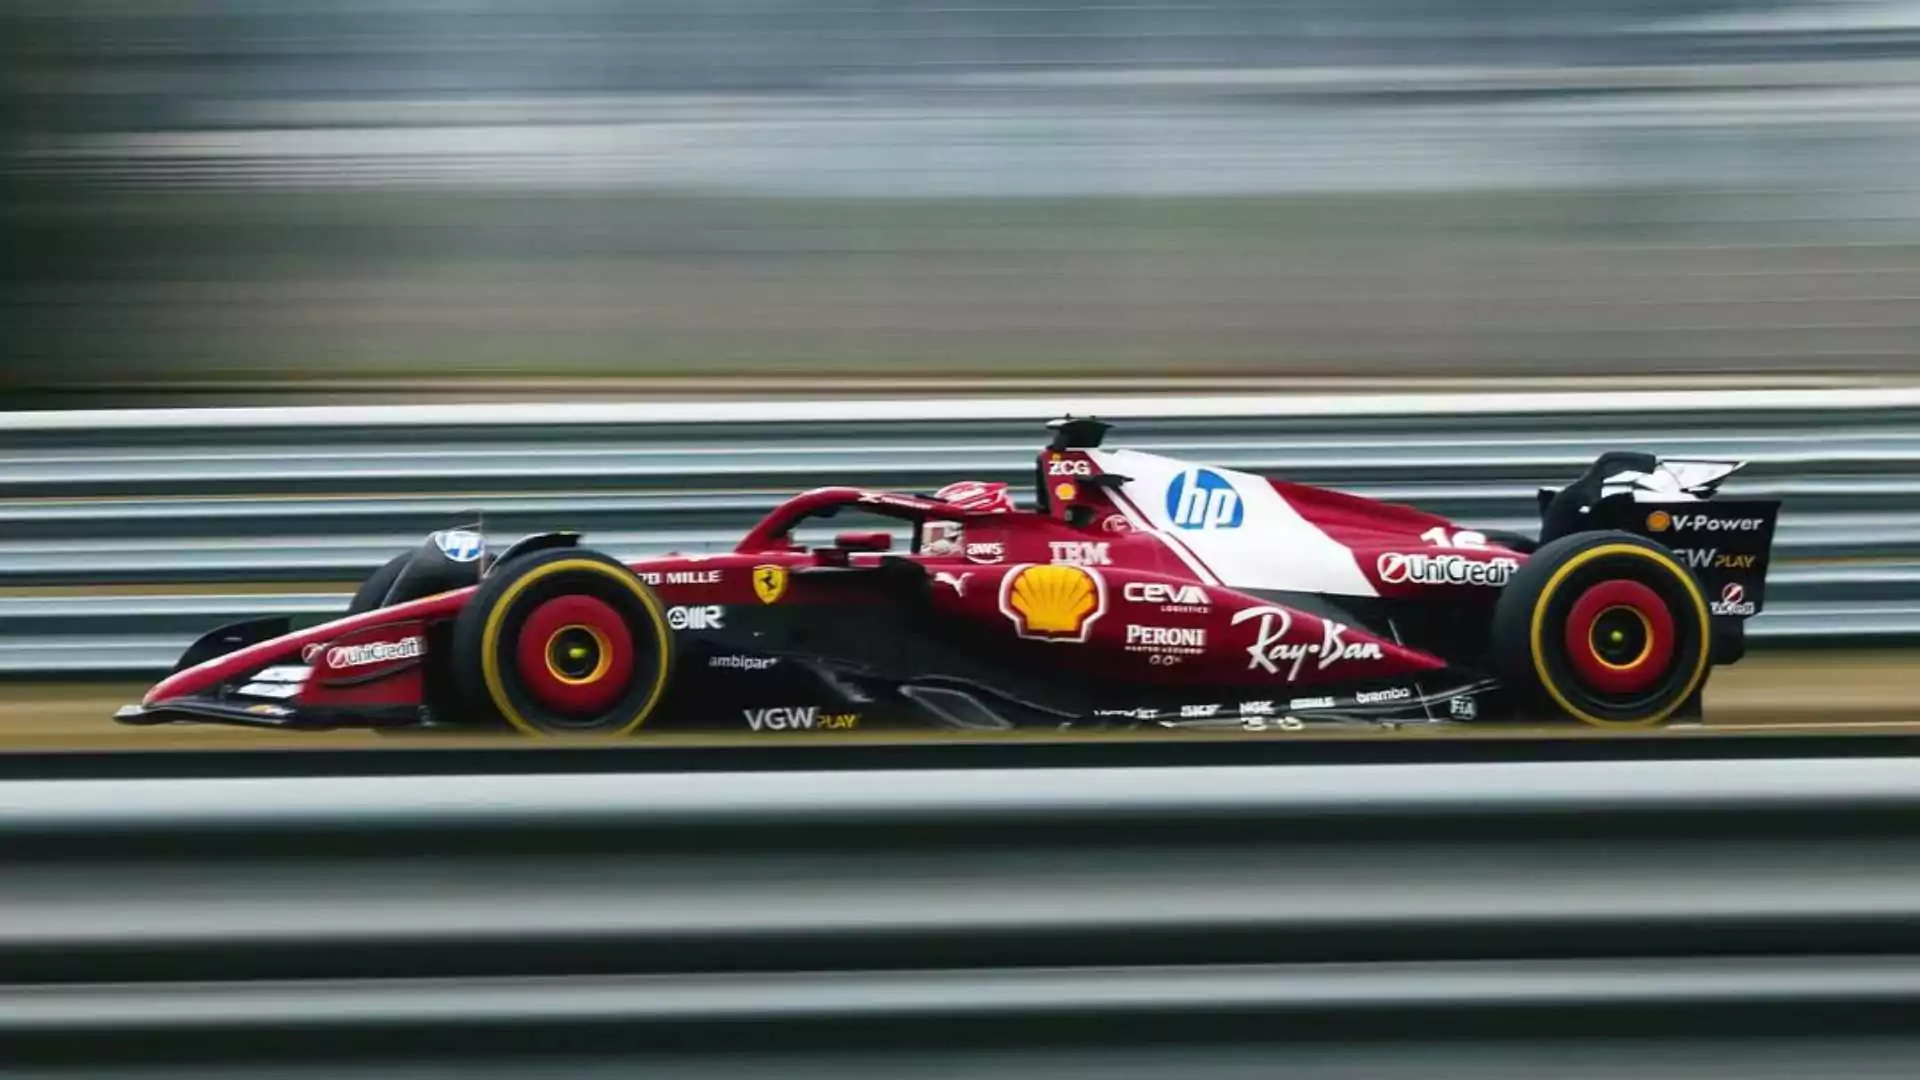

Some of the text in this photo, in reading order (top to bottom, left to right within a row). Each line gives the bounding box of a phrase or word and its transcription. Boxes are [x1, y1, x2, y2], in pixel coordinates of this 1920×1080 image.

[1048, 461, 1091, 475] ZCG
[1174, 469, 1236, 529] hp
[1672, 514, 1764, 532] V-Power
[966, 542, 1004, 556] aws
[1048, 541, 1112, 565] IBM
[666, 570, 723, 584] MILLE
[1124, 582, 1213, 604] CEVA
[1126, 624, 1206, 646] PERONI
[1356, 687, 1412, 704] brembo
[1451, 699, 1474, 715] FIA
[742, 706, 860, 731] VGW PLAY
